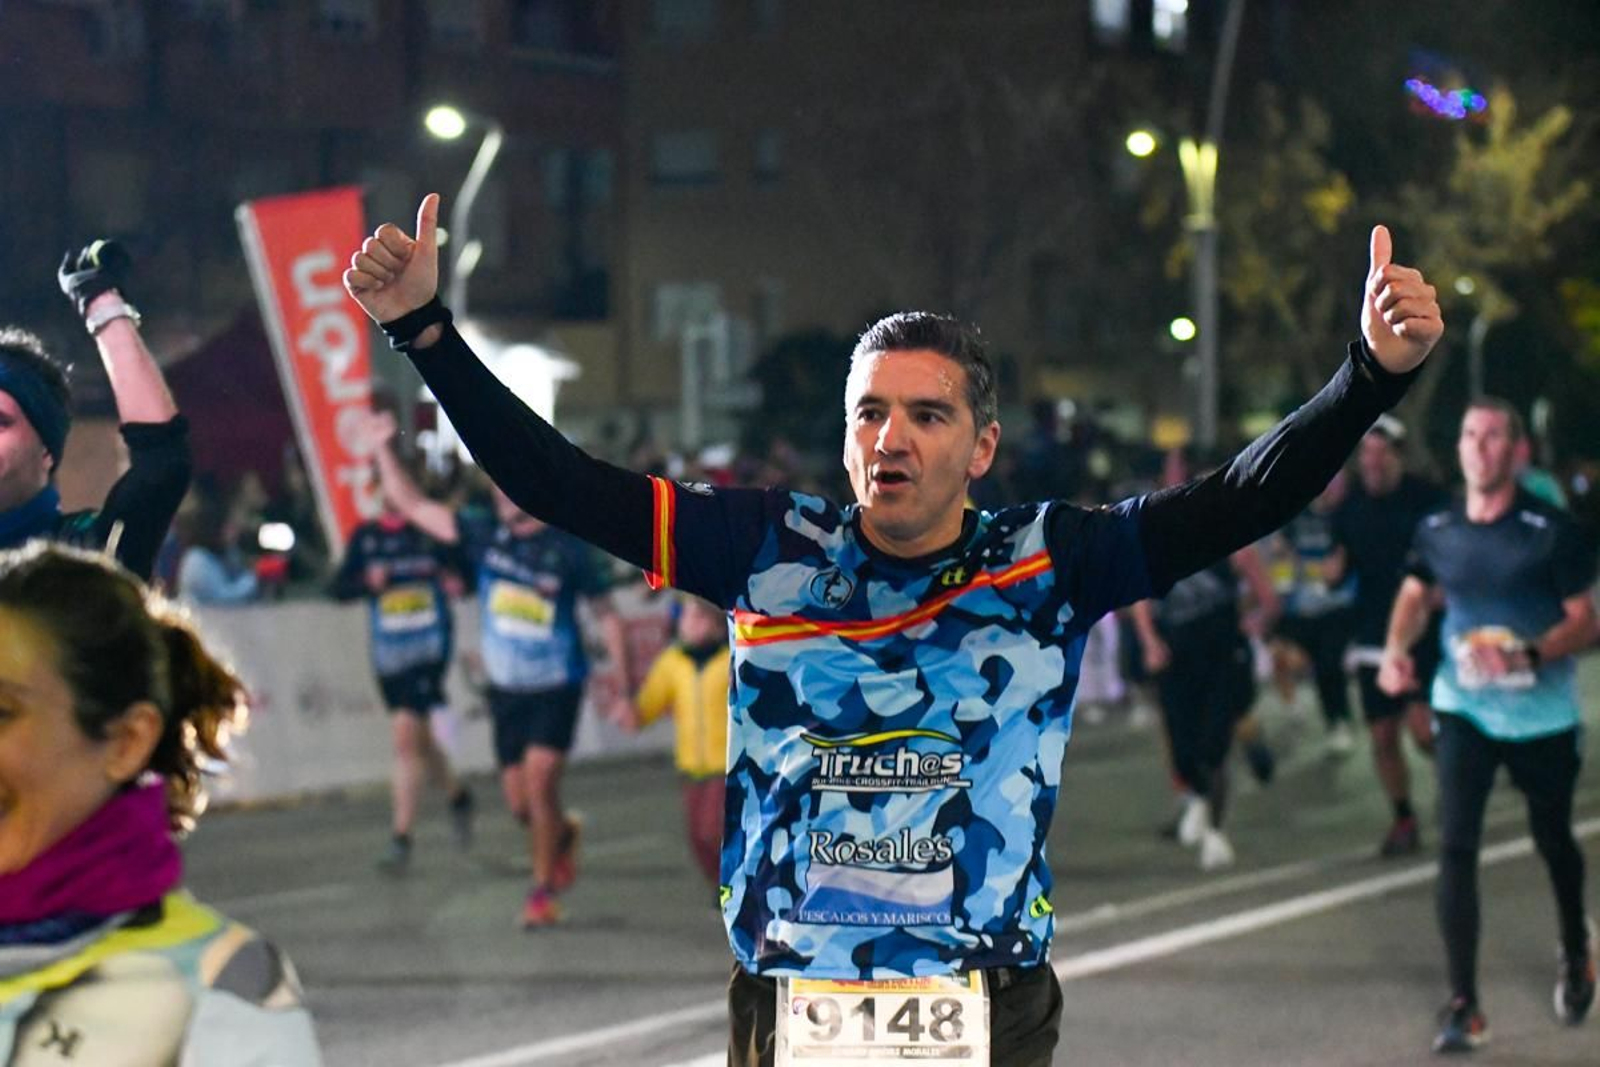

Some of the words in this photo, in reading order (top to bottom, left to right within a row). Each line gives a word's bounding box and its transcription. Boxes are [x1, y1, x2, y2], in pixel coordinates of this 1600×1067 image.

[812, 746, 962, 776] Truch@s
[809, 828, 952, 865] Rosales
[800, 908, 868, 923] PESCADOS
[871, 911, 881, 924] Y
[806, 997, 965, 1042] 9148
